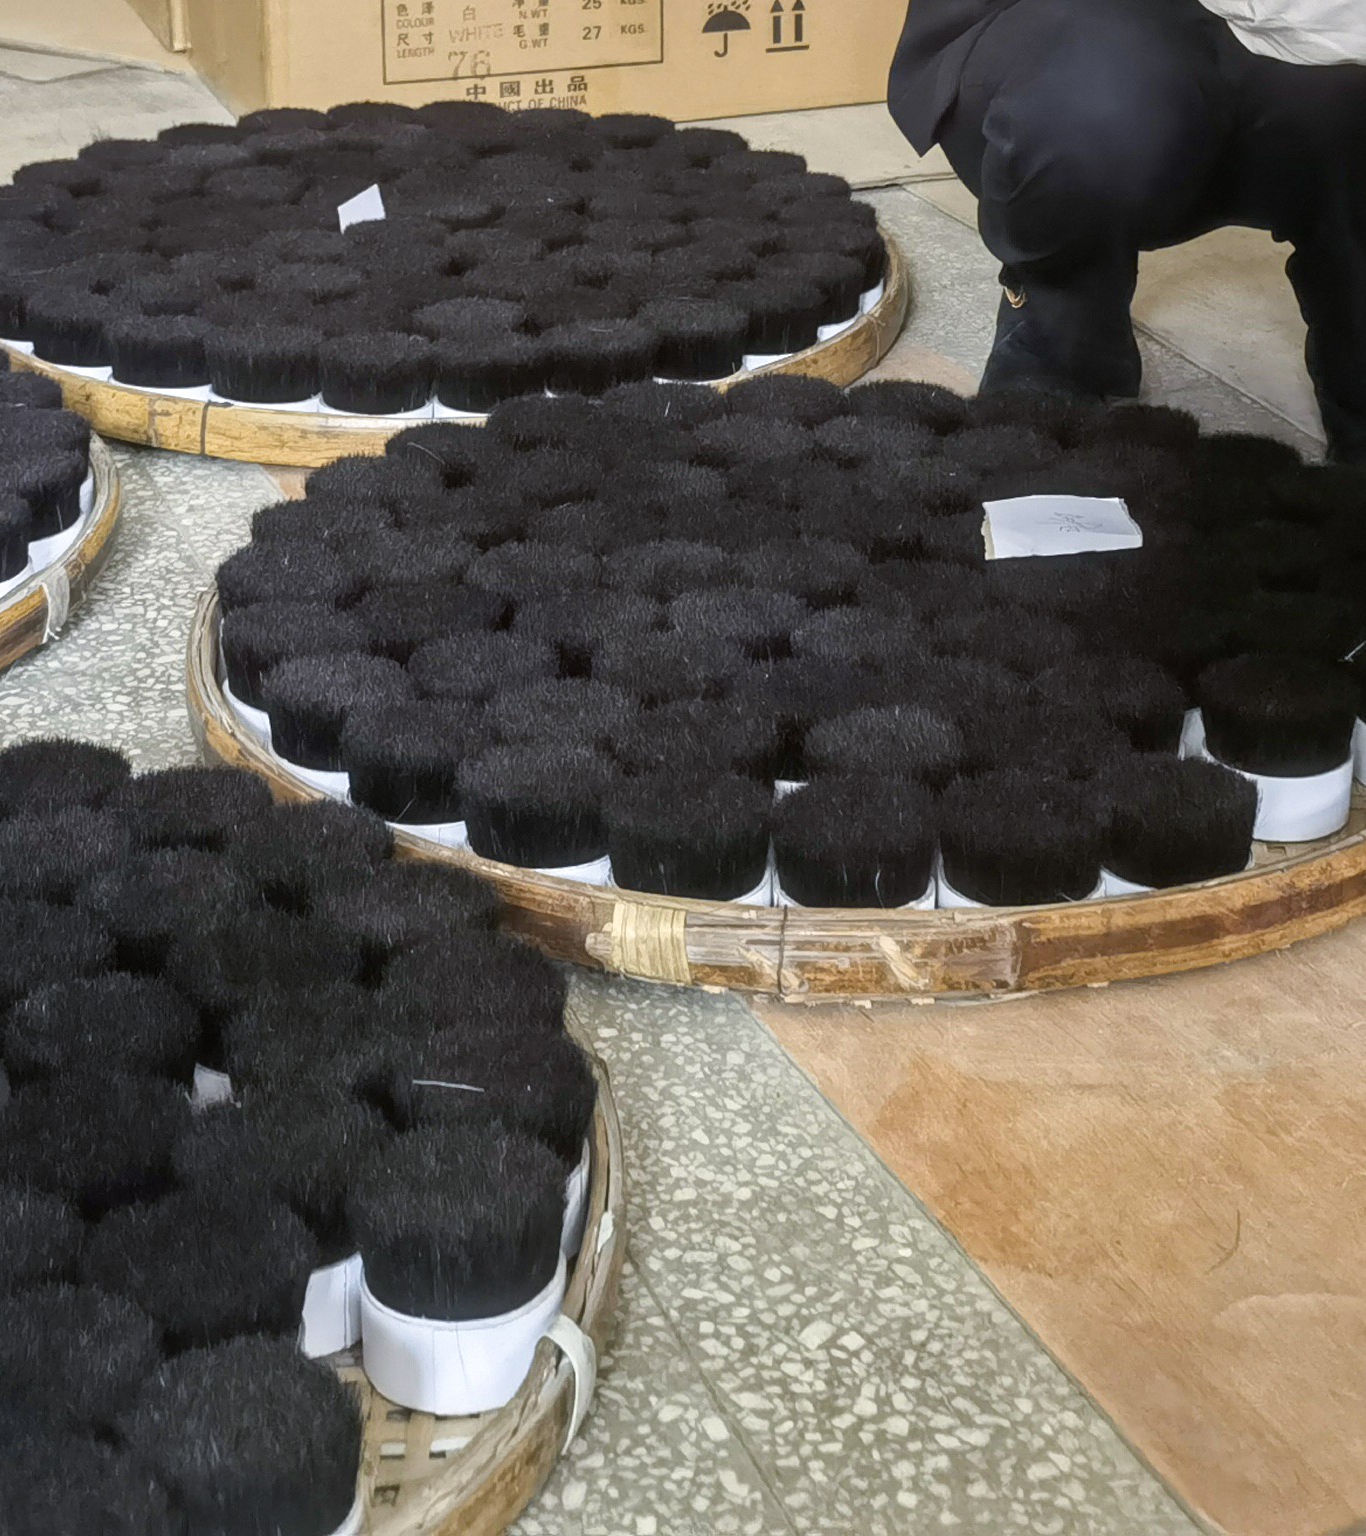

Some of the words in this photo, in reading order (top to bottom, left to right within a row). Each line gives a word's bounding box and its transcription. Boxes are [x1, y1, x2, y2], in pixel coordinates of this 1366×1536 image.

[582, 26, 602, 40] 27
[466, 75, 588, 100] 中國出品
[549, 95, 587, 110] CHINA
